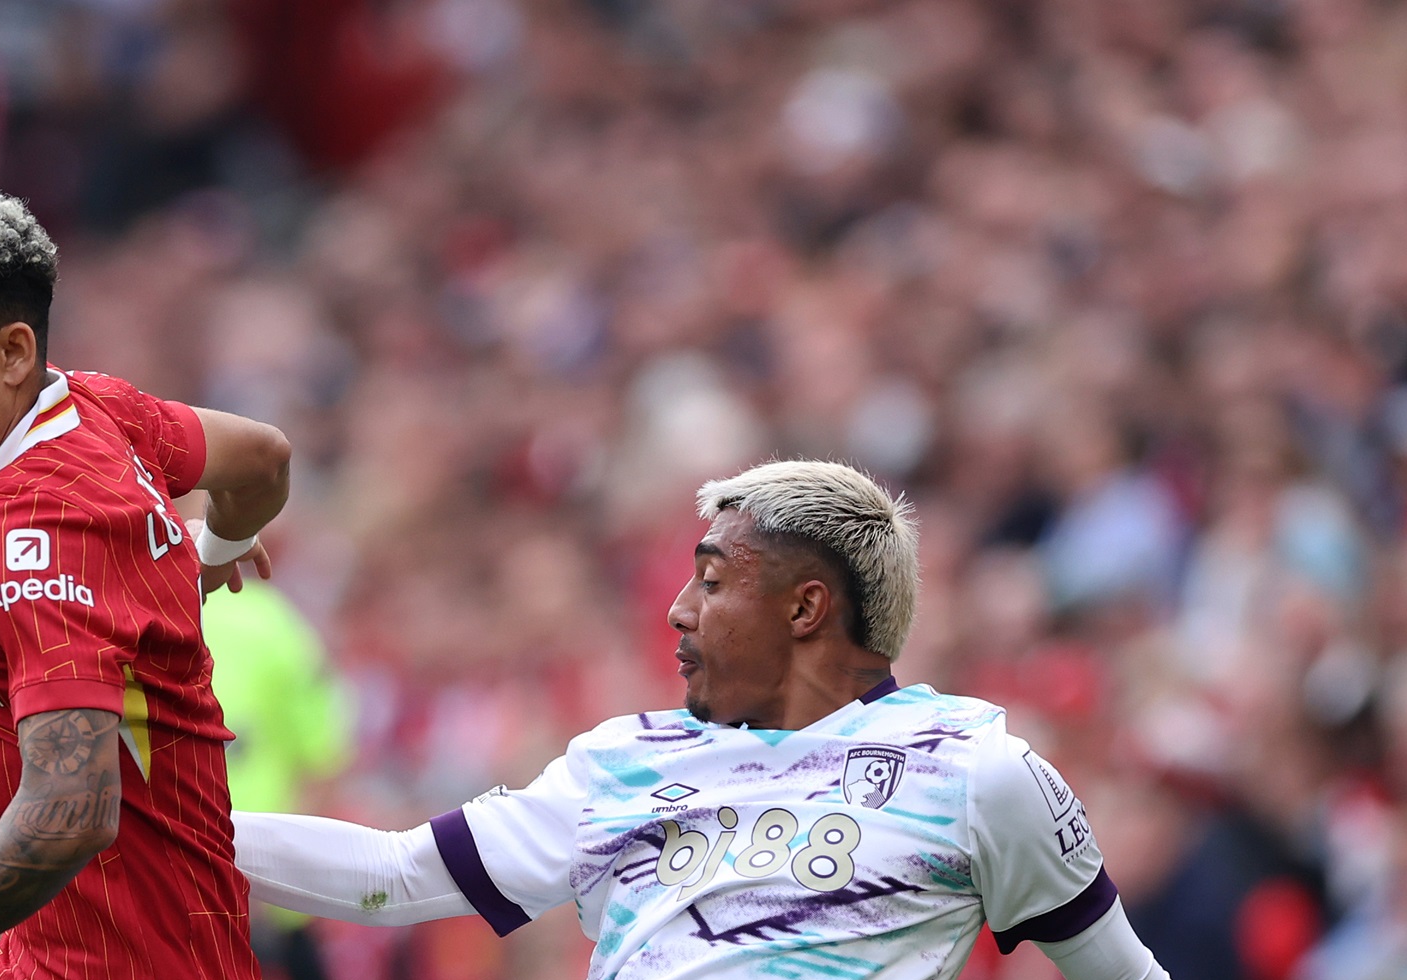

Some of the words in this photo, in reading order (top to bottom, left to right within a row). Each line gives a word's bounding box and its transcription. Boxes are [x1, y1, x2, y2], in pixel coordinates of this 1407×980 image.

[861, 749, 905, 762] BOURNEMOUTH
[652, 804, 688, 813] umbro
[655, 806, 862, 901] bj88
